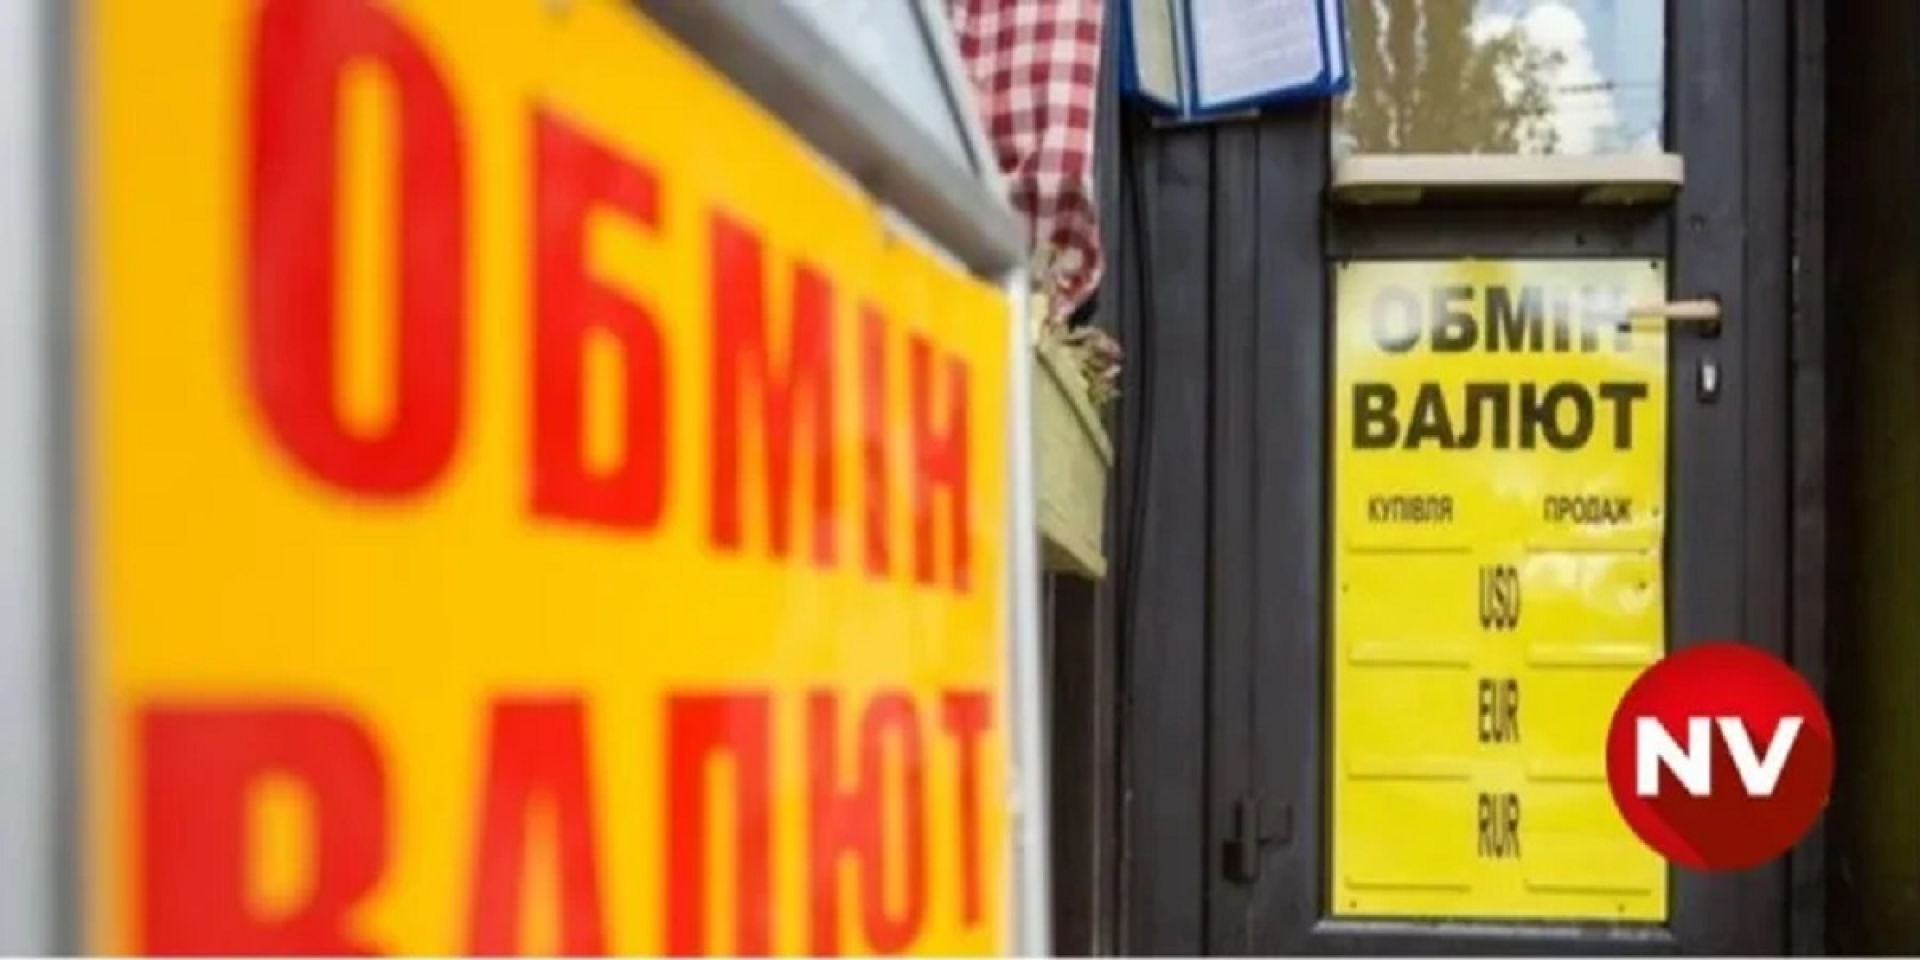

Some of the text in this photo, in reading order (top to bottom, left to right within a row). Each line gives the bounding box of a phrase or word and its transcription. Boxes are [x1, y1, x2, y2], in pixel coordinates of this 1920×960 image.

[241, 0, 972, 595] ОБМІН
[1371, 284, 1632, 354] ОБМІН
[1352, 380, 1649, 451] ВАЛЮТ
[1367, 495, 1633, 525] КУПІВЛЯ ПРОДАЖ
[1478, 564, 1520, 630] USD
[1477, 678, 1520, 743] EUR
[134, 688, 993, 957] ВАЛЮТ
[1477, 792, 1521, 858] RUR
